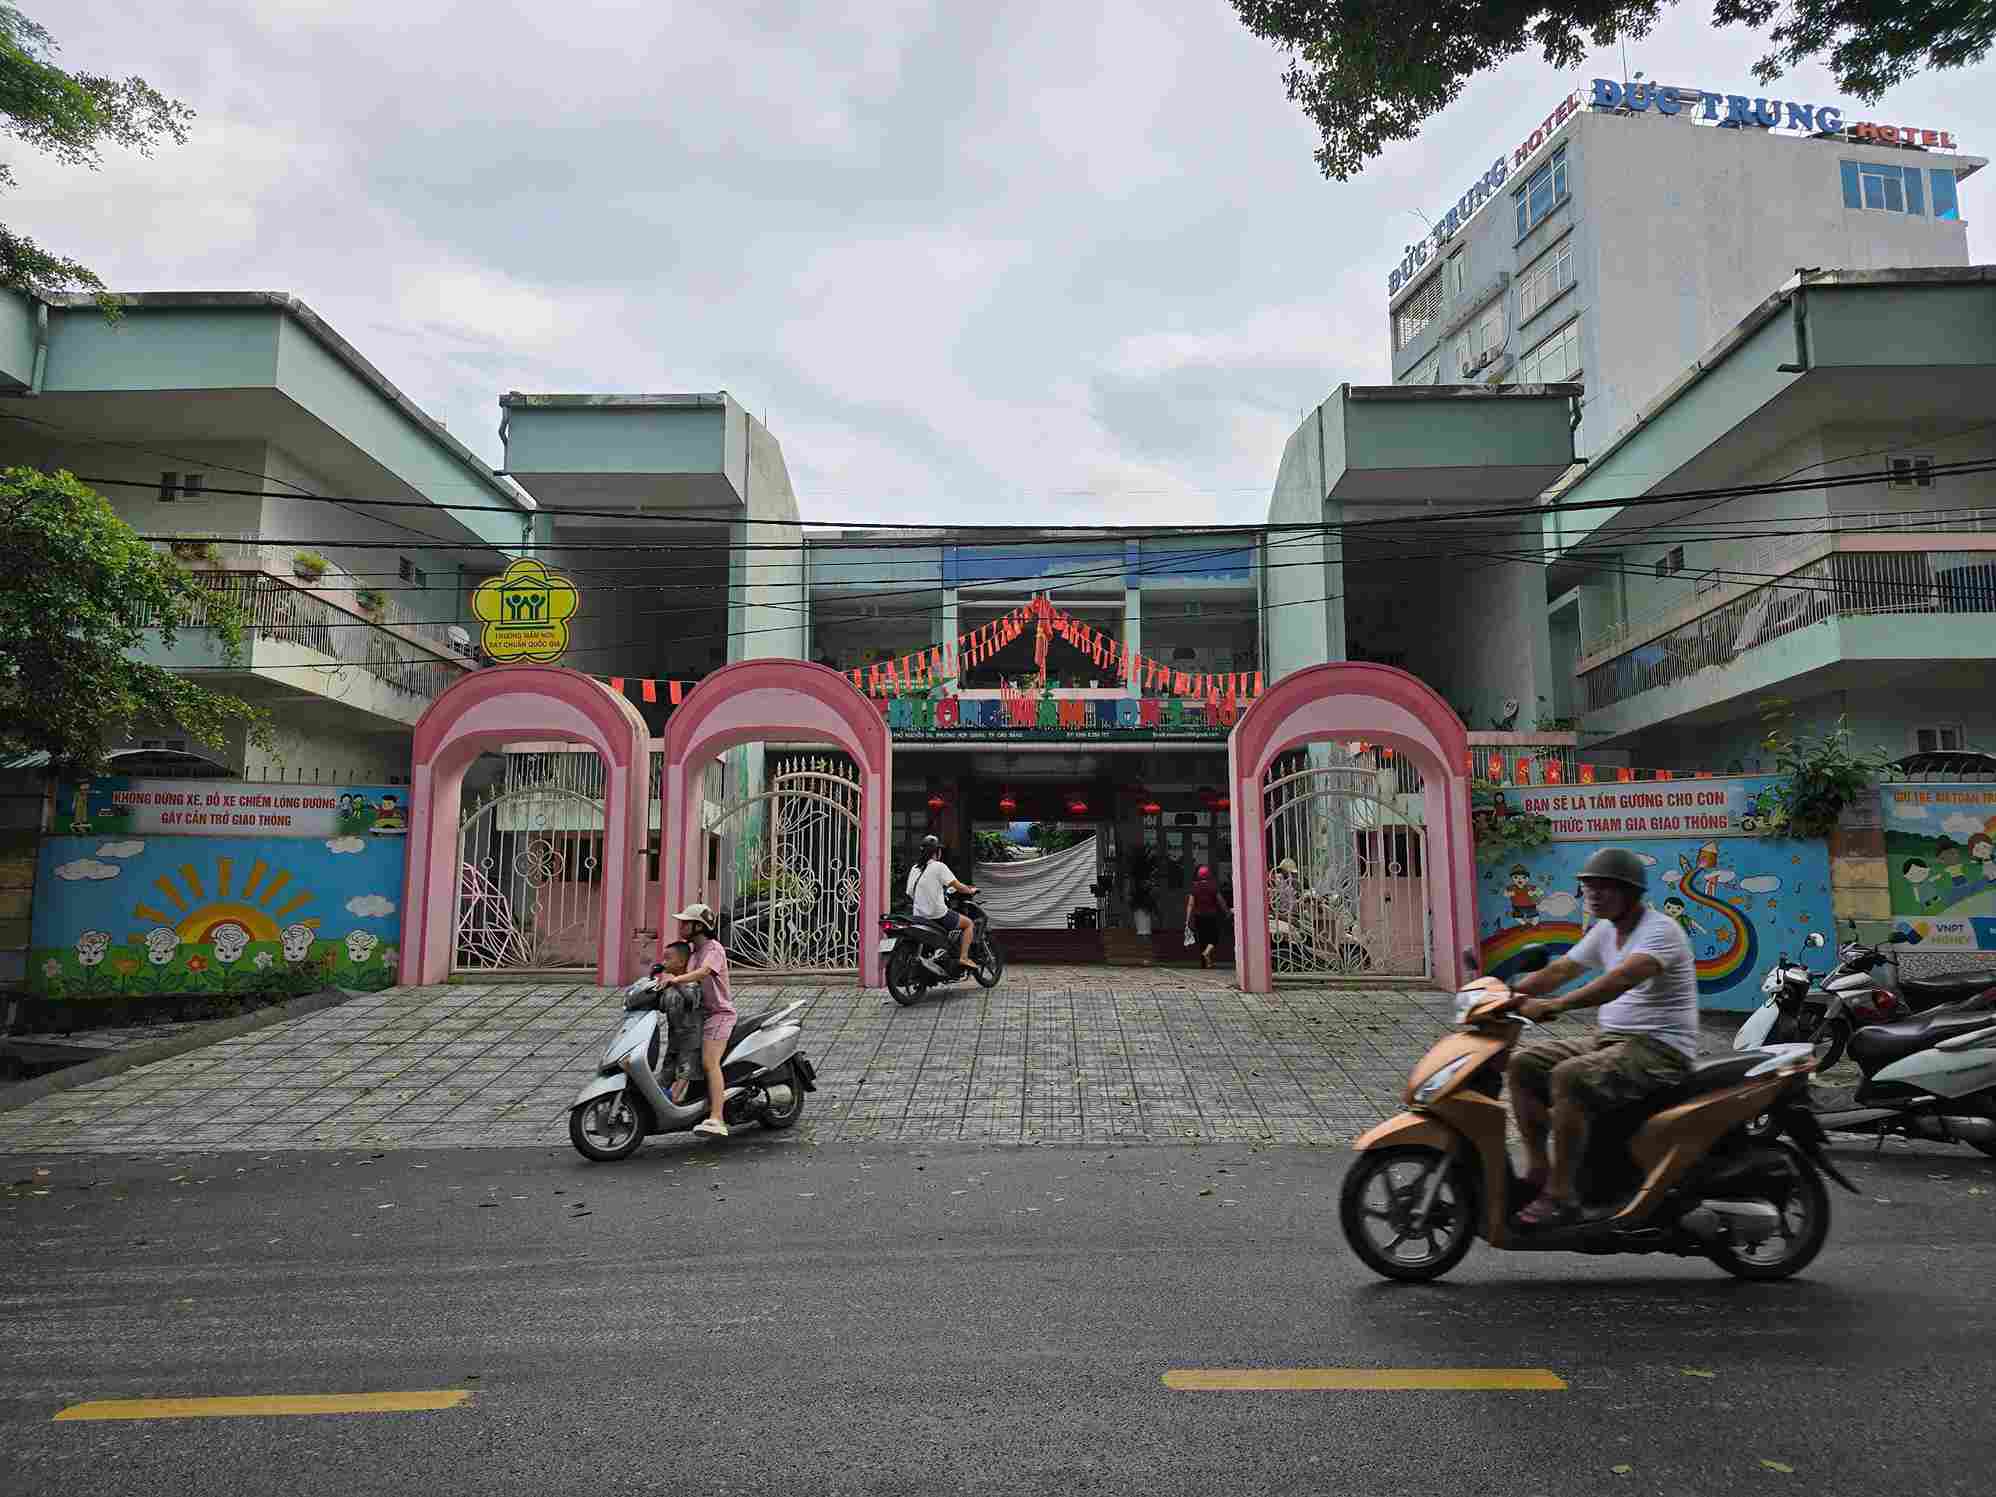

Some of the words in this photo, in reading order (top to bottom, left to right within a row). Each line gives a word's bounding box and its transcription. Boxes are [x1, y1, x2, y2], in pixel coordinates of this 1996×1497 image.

[1591, 78, 1681, 114] ĐỨC
[1701, 92, 1841, 133] TRUNG
[1855, 121, 1957, 149] HOTEL
[1431, 155, 1505, 246] TRUNG
[1514, 93, 1578, 168] HOTEL
[223, 795, 237, 807] XE
[1525, 797, 1549, 815] BẠN
[1552, 794, 1569, 811] SẼ
[1589, 791, 1616, 809] TẤM
[1620, 792, 1663, 809] GƯƠNG
[1667, 792, 1693, 807] CHO
[1696, 791, 1725, 806] CON
[186, 809, 208, 825] CẢN
[209, 809, 229, 825] TRỞ
[232, 813, 256, 826] GIAO
[258, 812, 292, 827] THÔNG
[1552, 815, 1584, 833] THỨC
[1587, 816, 1622, 832] THAM
[1625, 816, 1647, 832] GIA
[1650, 815, 1680, 831] GIAO
[1684, 812, 1728, 830] THÔNG
[1935, 923, 1965, 934] VNPT
